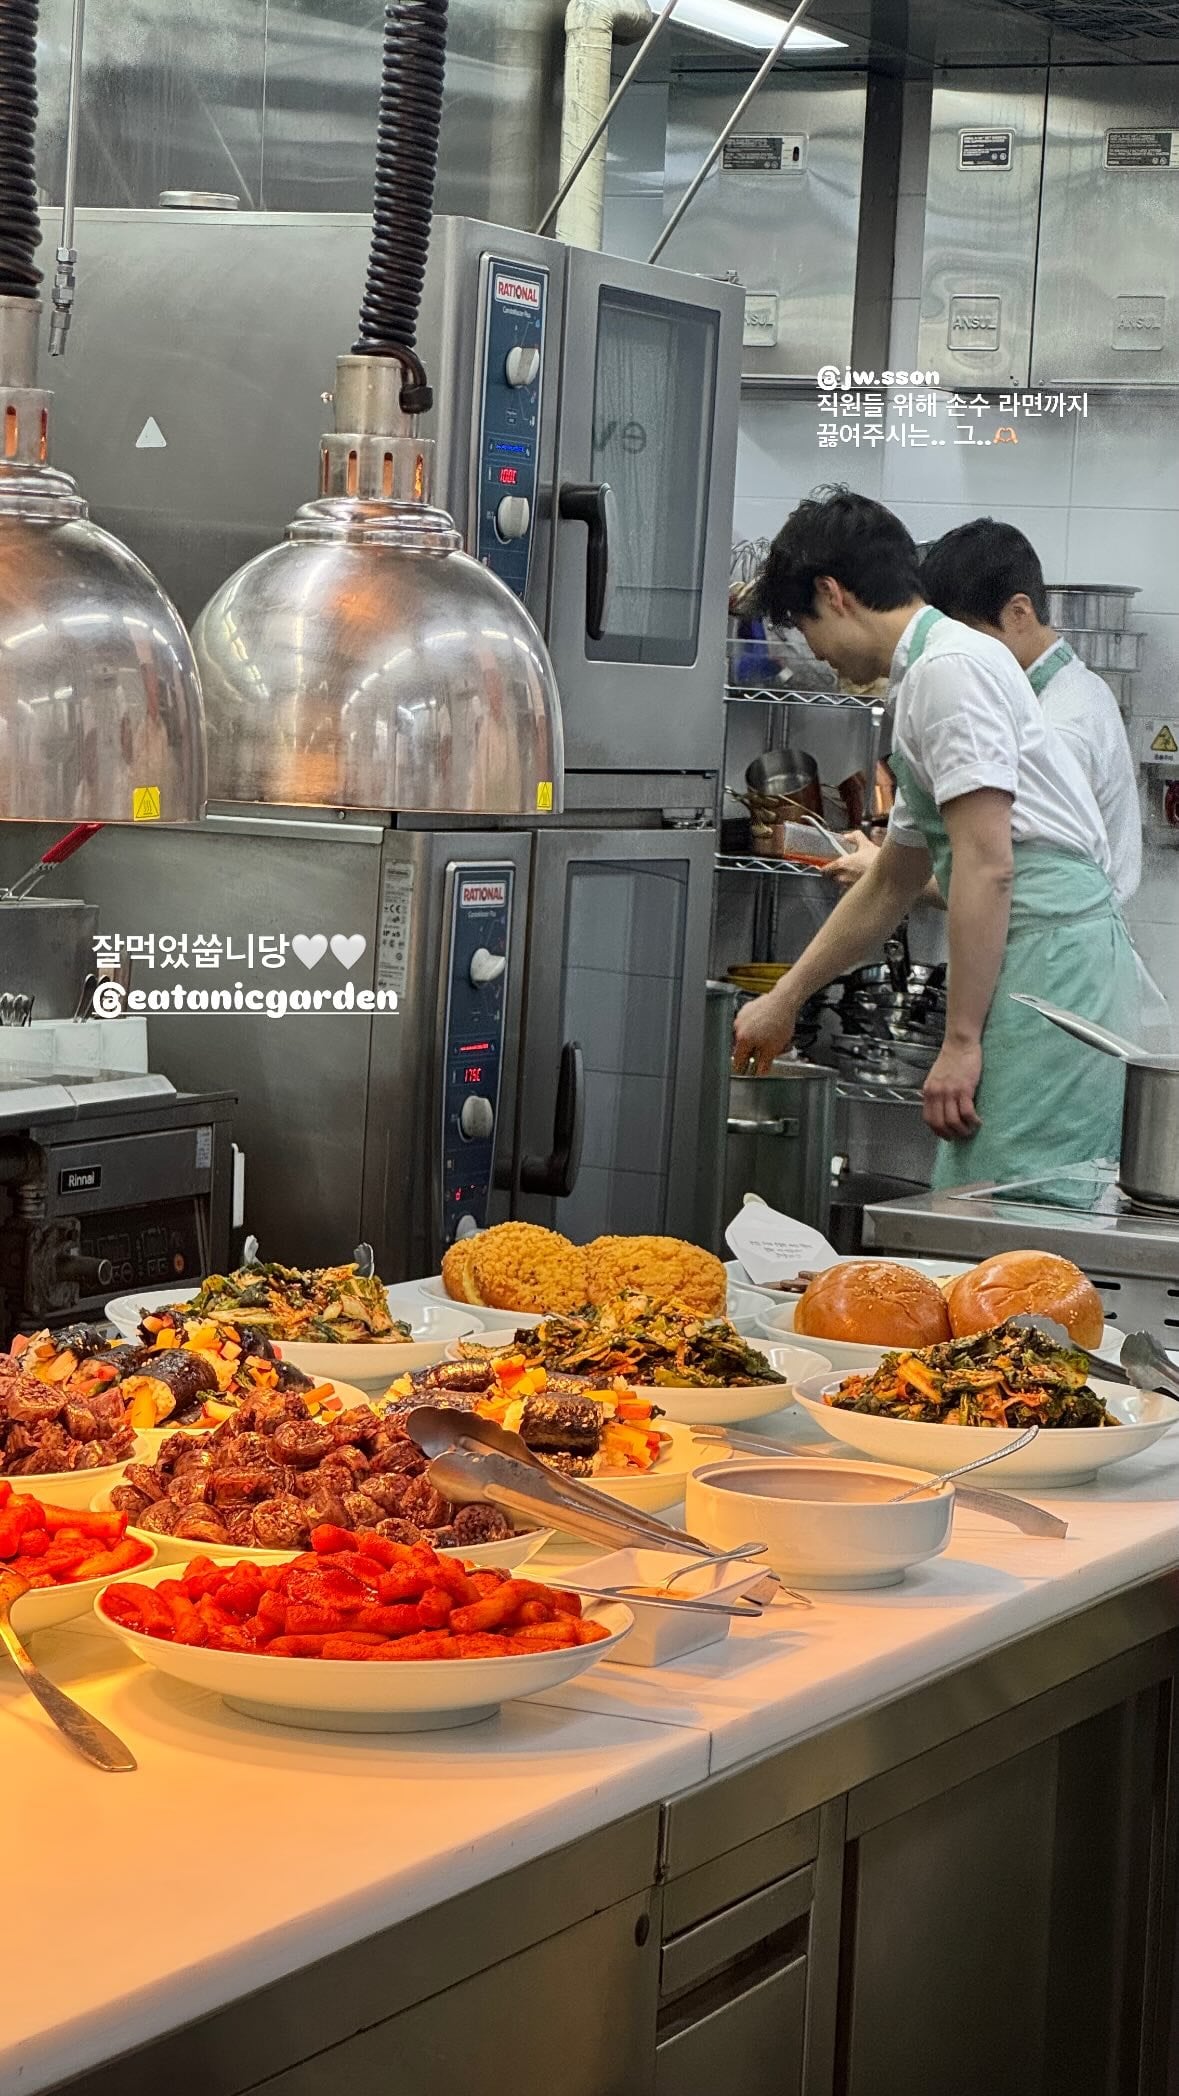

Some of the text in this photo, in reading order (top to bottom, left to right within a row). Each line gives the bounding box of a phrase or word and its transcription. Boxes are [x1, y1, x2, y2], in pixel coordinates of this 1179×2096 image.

[498, 282, 537, 303] RATIONAL
[744, 311, 774, 327] NSUL
[952, 315, 997, 331] ANSUL
[1118, 315, 1161, 331] ANSUL
[463, 887, 503, 902] RATIONAL
[68, 1171, 95, 1188] Rinnai
